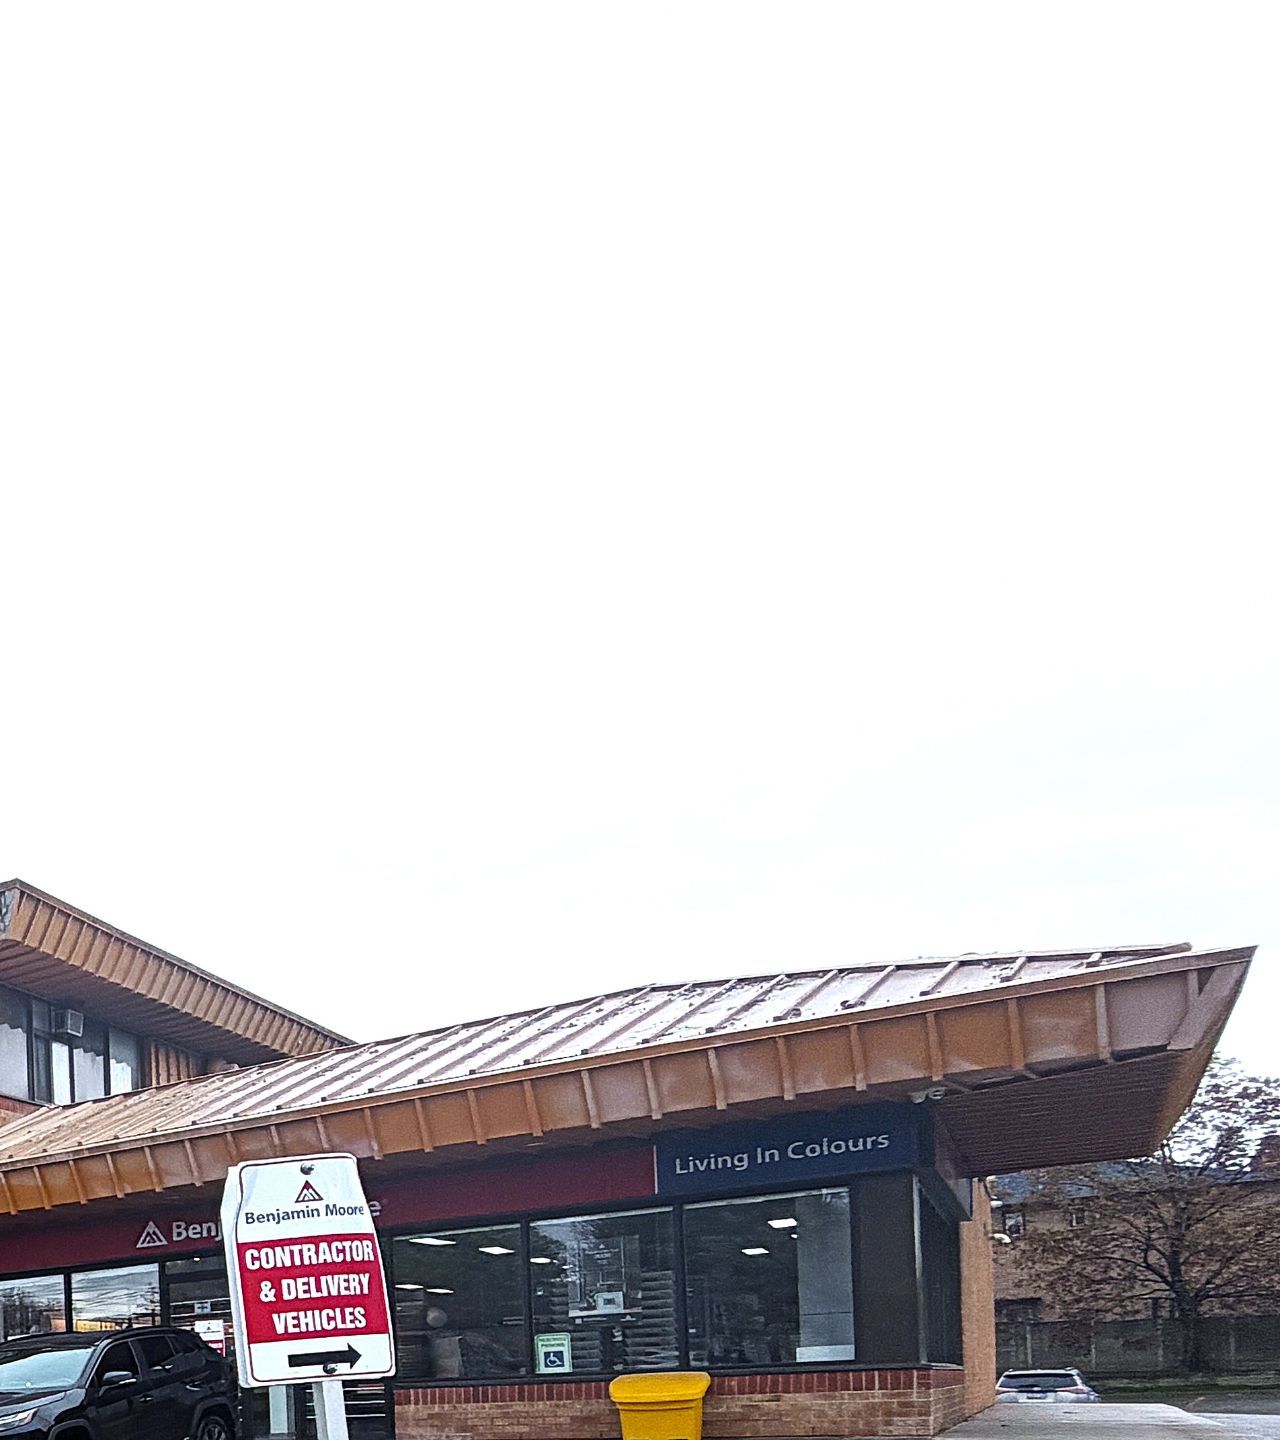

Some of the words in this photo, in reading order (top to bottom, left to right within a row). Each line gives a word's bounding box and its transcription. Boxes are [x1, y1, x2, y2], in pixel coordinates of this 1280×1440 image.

[675, 1151, 749, 1174] Living
[757, 1147, 780, 1163] In
[787, 1134, 890, 1159] Colours
[245, 1206, 321, 1225] Benjamin
[325, 1203, 365, 1217] Moore
[172, 1220, 223, 1242] Benj
[245, 1240, 375, 1271] CONTRACTOR
[259, 1280, 276, 1303] &
[281, 1273, 370, 1301] DELIVERY
[272, 1307, 367, 1335] VEHICLES
